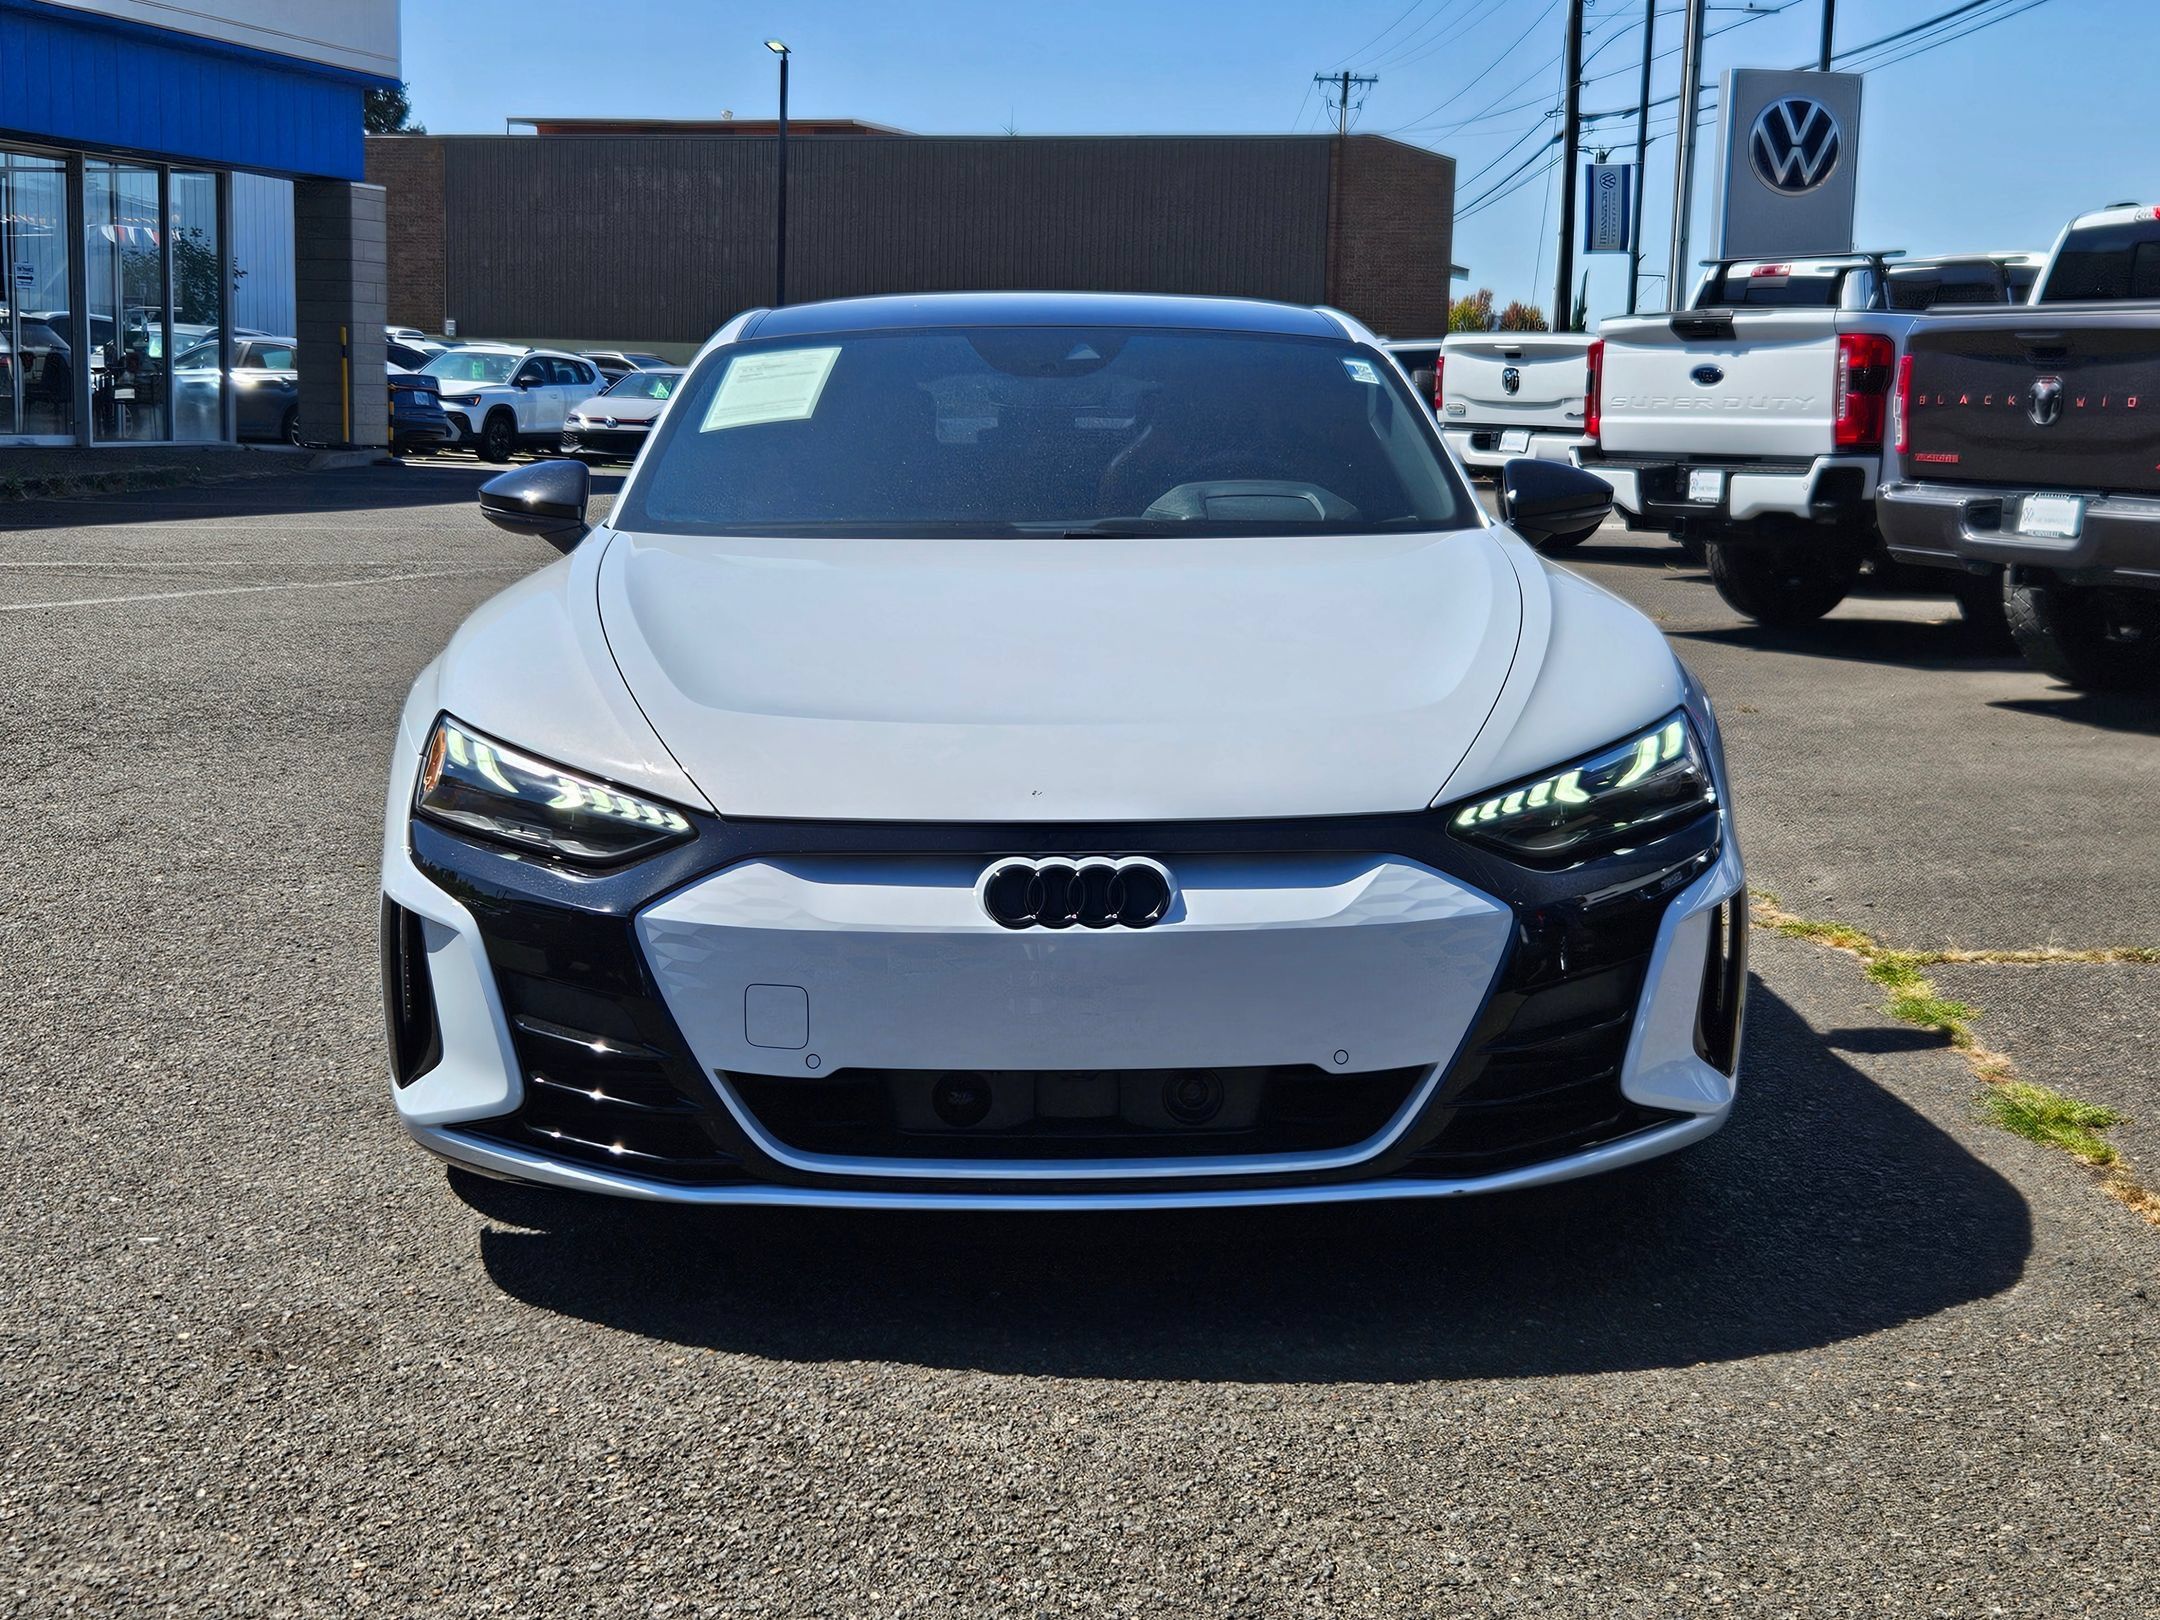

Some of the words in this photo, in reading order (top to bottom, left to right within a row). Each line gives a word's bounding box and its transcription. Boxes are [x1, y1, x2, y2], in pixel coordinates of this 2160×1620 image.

[1611, 396, 1713, 409] SUPER
[1723, 396, 1815, 410] DUTY
[1919, 394, 2017, 406] BLACK
